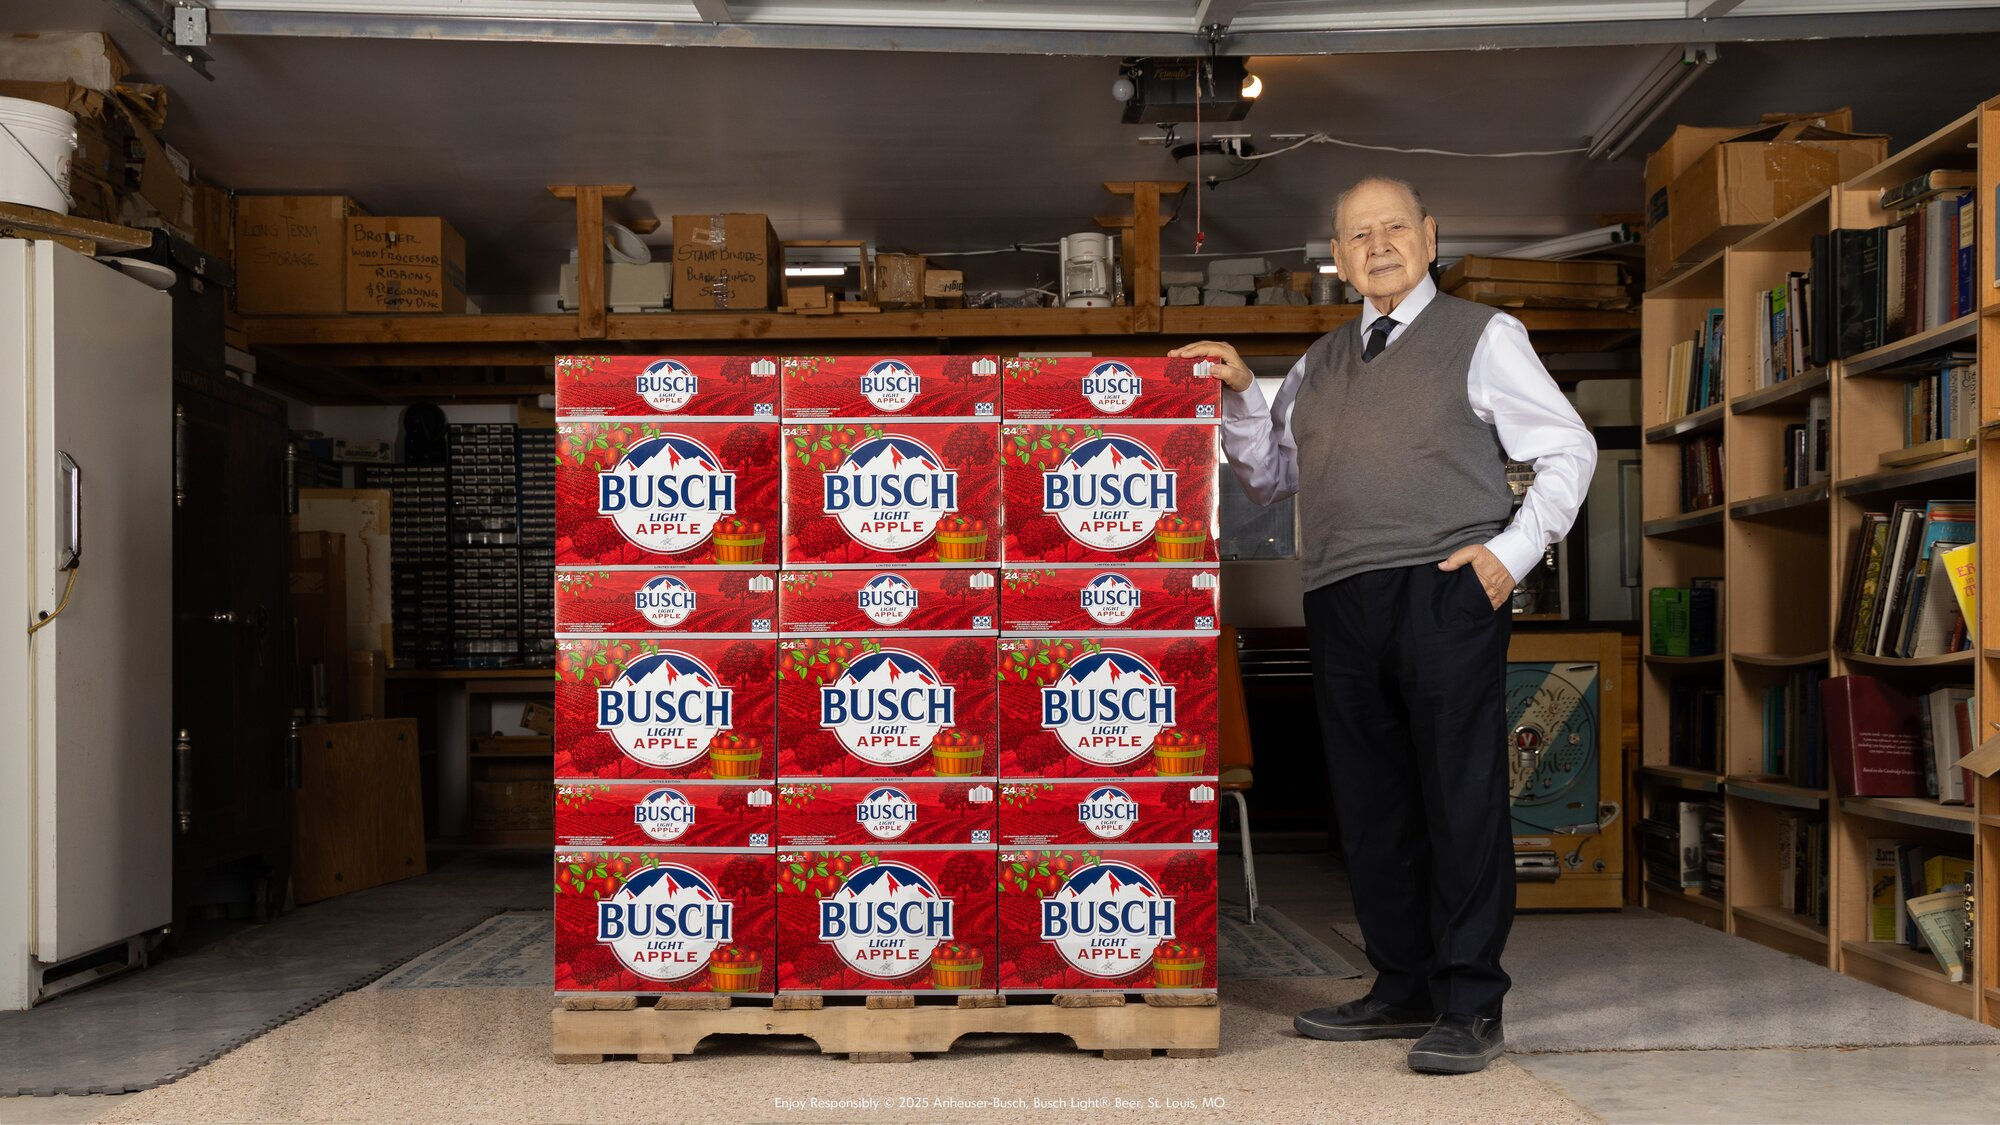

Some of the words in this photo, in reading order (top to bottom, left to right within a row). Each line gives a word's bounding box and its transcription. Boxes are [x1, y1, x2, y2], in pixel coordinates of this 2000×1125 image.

[280, 215, 320, 244] TERM
[252, 246, 319, 267] STORAGE
[678, 244, 718, 261] STAMP
[720, 247, 764, 266] BINDERS
[375, 267, 432, 283] RIBBONS
[638, 377, 696, 393] BUSCH
[862, 377, 919, 392] BUSCH
[1083, 378, 1140, 394] BUSCH
[602, 475, 732, 511] BUSCH
[826, 474, 954, 509] BUSCH
[1046, 474, 1173, 509] BUSCH
[650, 513, 687, 522] LIGHT
[874, 512, 910, 520] LIGHT
[1093, 511, 1129, 520] LIGHT
[636, 524, 700, 534] APPLE
[861, 522, 923, 532] APPLE
[1080, 521, 1143, 532] APPLE
[637, 593, 695, 608] BUSCH
[860, 591, 917, 607] BUSCH
[1082, 590, 1139, 606] BUSCH
[600, 691, 729, 726] BUSCH
[823, 689, 952, 723] BUSCH
[1045, 689, 1173, 724] BUSCH
[647, 728, 684, 736] LIGHT
[870, 726, 907, 734] LIGHT
[1092, 726, 1128, 734] LIGHT
[634, 738, 697, 749] APPLE
[857, 736, 920, 746] APPLE
[1078, 736, 1142, 747] APPLE
[636, 807, 694, 822] BUSCH
[858, 805, 916, 820] BUSCH
[1080, 804, 1137, 820] BUSCH
[600, 904, 730, 939] BUSCH
[822, 902, 951, 937] BUSCH
[1044, 901, 1172, 936] BUSCH
[647, 941, 684, 950] LIGHT
[869, 939, 905, 948] LIGHT
[1091, 938, 1127, 947] LIGHT
[634, 952, 697, 962] APPLE
[856, 950, 919, 960] APPLE
[1078, 949, 1141, 959] APPLE
